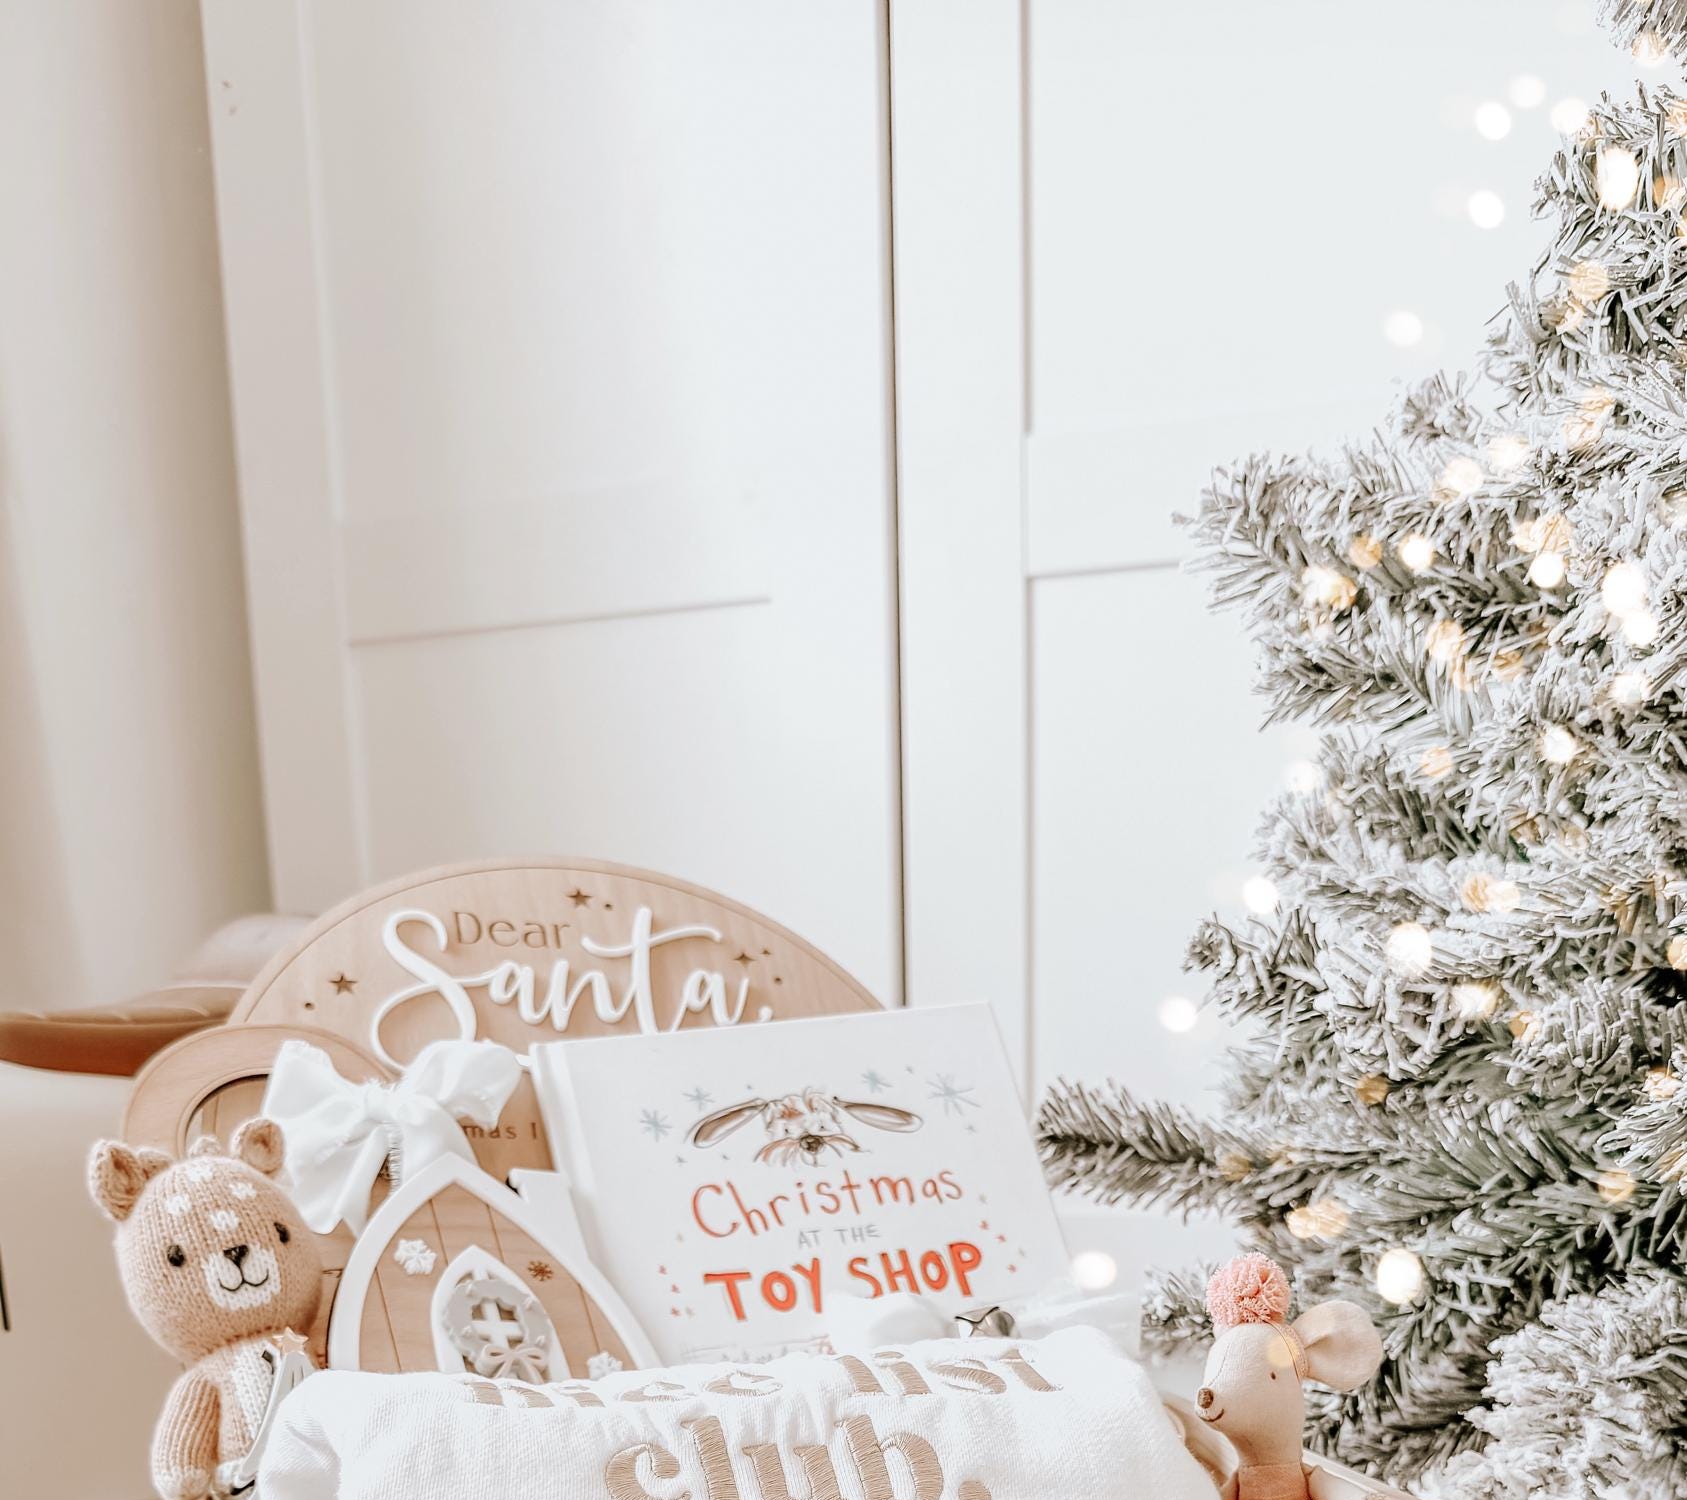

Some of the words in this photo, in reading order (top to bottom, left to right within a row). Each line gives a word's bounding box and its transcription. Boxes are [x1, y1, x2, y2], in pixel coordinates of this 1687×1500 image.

[452, 911, 571, 949] Dear
[691, 1169, 963, 1237] Christmas
[798, 1229, 821, 1248] AT
[834, 1223, 881, 1245] THE
[703, 1256, 823, 1321] TOY
[847, 1241, 982, 1299] SHOP
